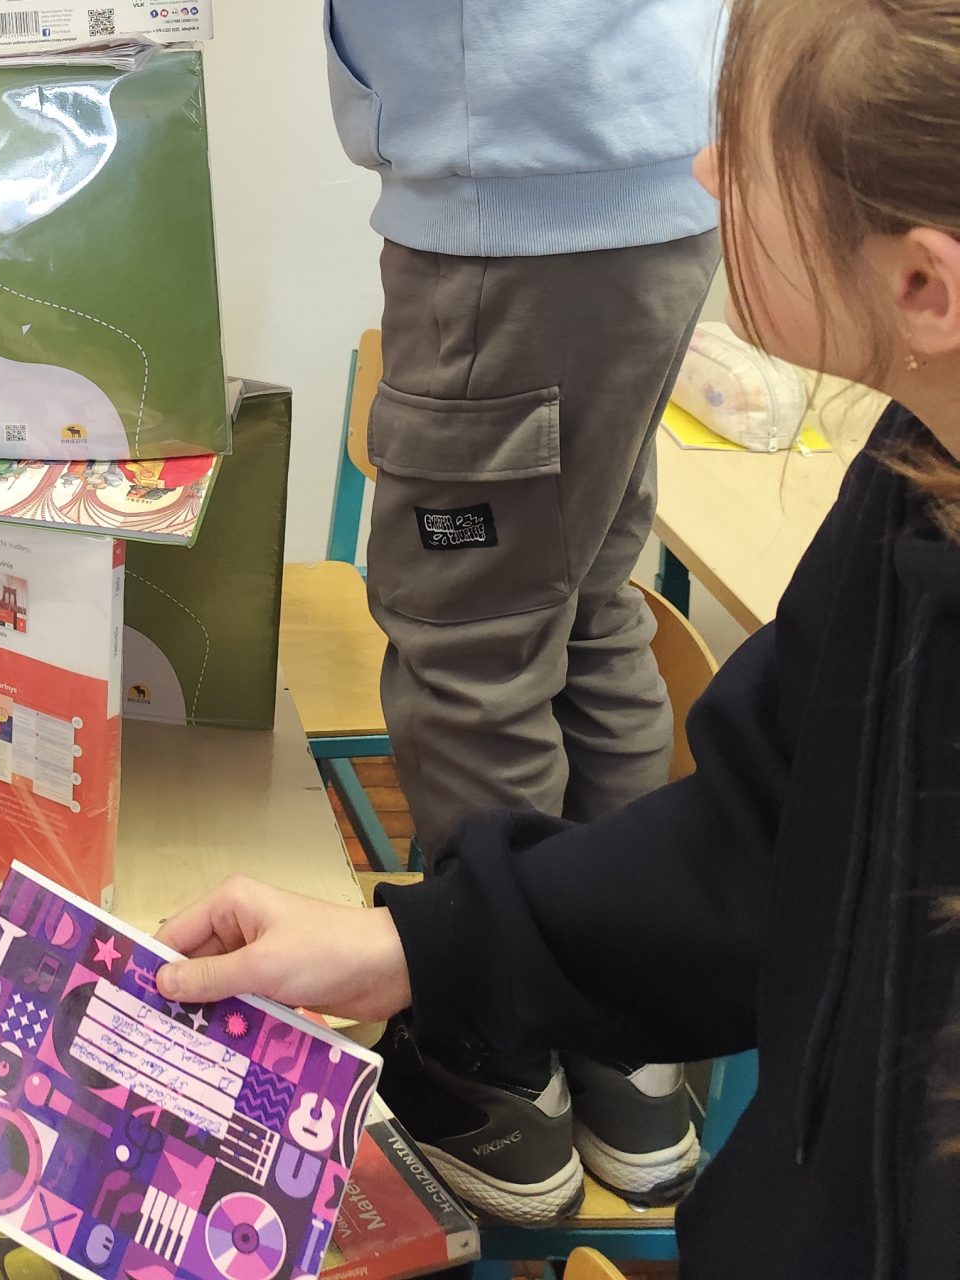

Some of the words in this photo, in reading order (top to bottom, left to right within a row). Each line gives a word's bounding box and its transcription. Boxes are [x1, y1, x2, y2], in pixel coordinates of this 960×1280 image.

[472, 1130, 522, 1155] VIKING
[388, 1137, 454, 1212] HORIZONTAI
[346, 1179, 386, 1230] Mate
